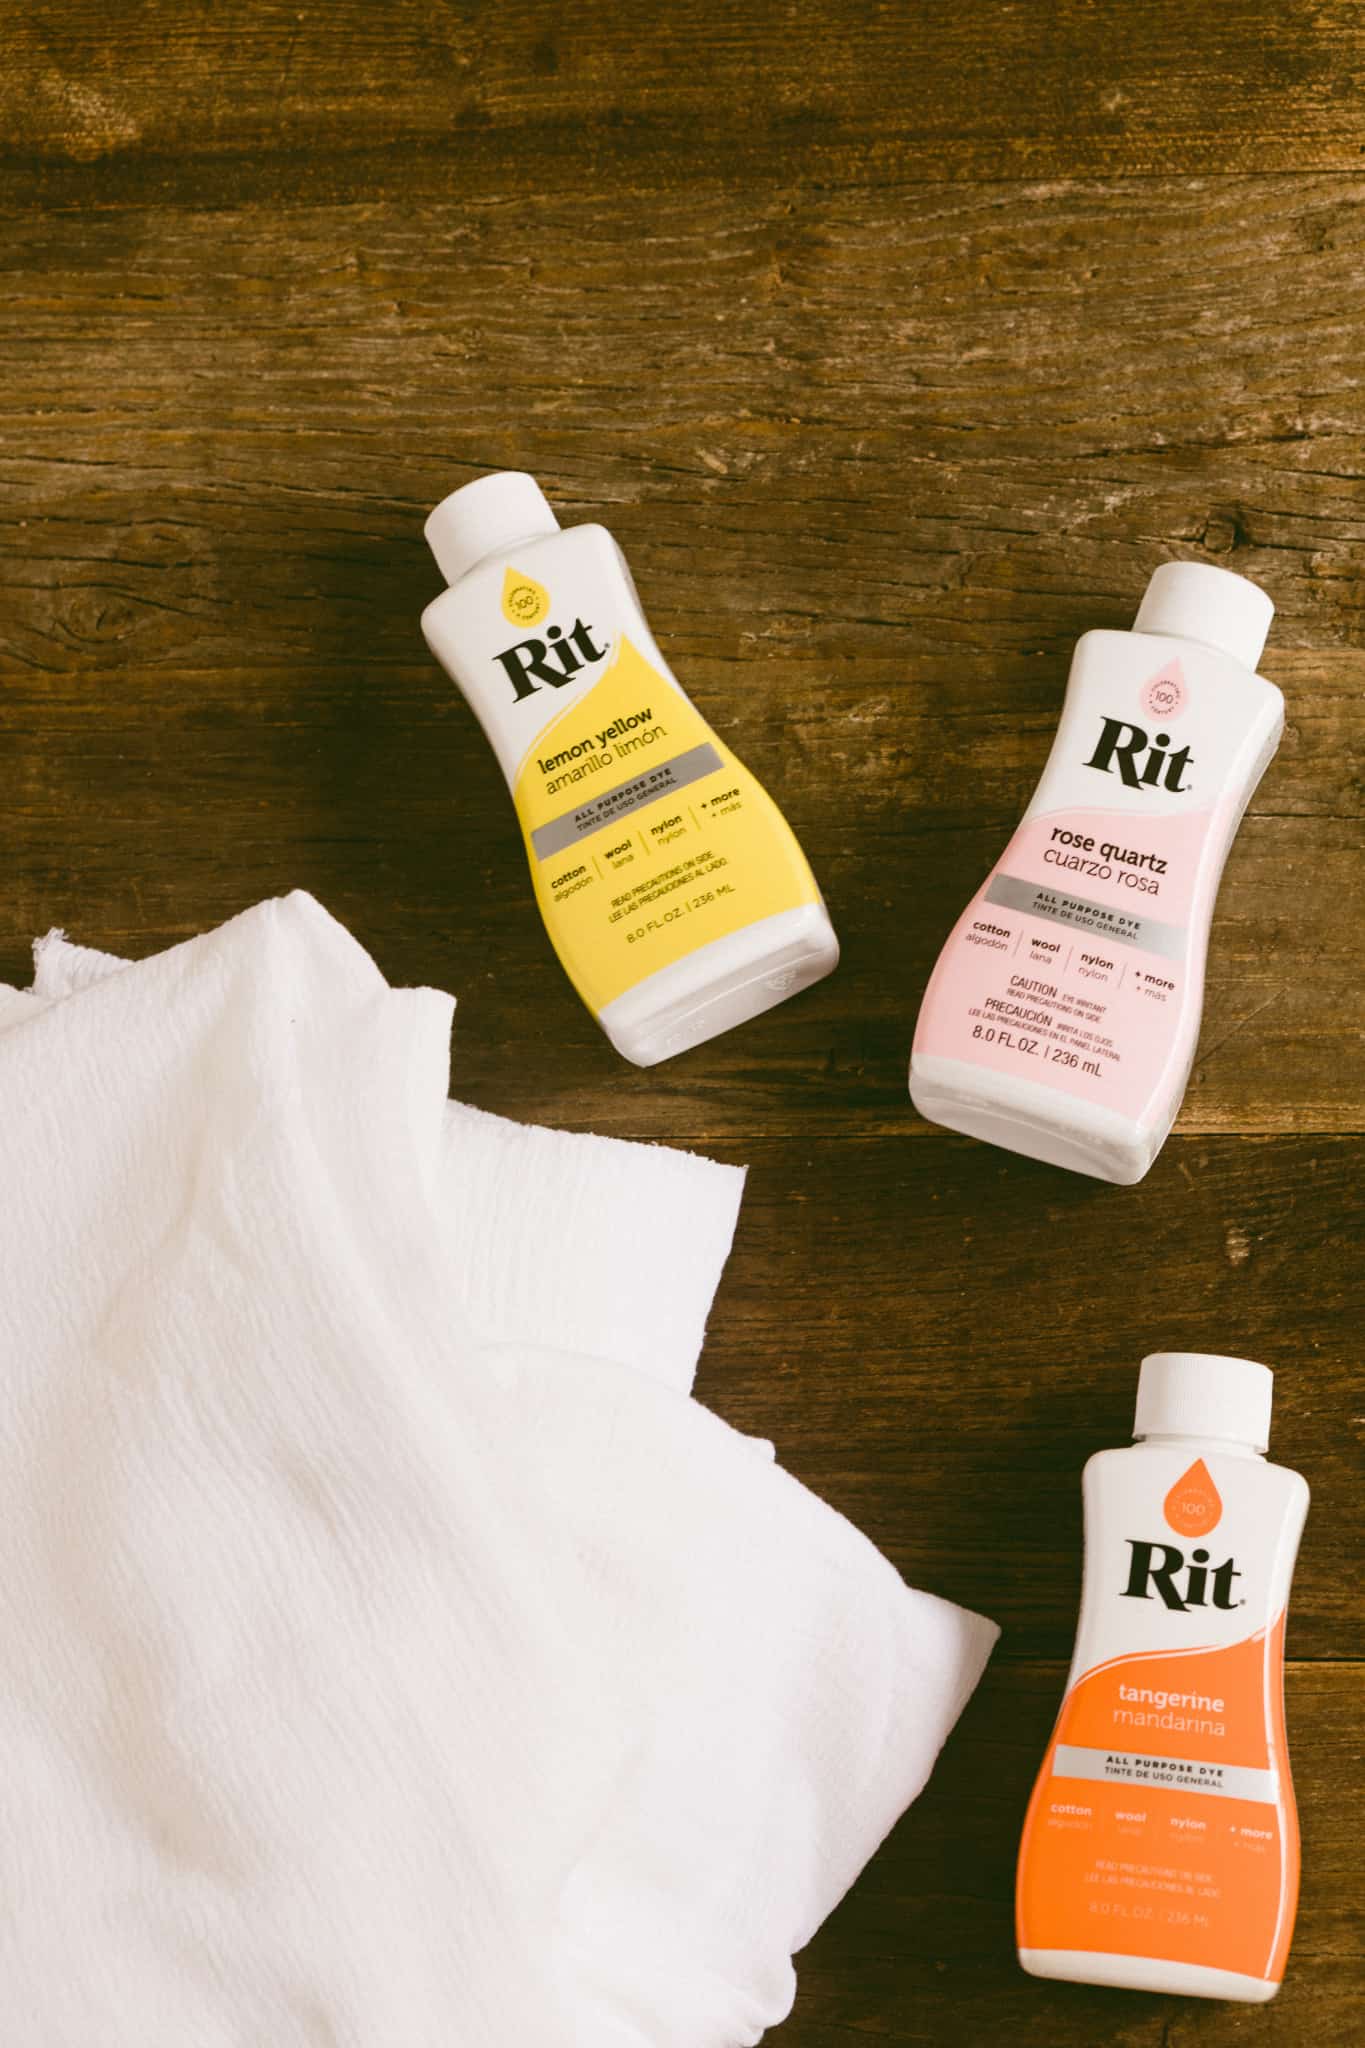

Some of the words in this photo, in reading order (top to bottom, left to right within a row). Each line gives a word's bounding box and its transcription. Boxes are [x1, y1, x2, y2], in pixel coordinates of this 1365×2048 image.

[515, 596, 533, 609] 100
[491, 617, 608, 703] Rit
[1156, 691, 1174, 704] 100
[537, 739, 595, 774] lemon
[595, 708, 652, 749] yellow
[546, 753, 613, 795] amarillo
[613, 725, 667, 758] limón
[1082, 716, 1194, 793] Rit
[575, 808, 594, 822] ALL
[597, 780, 647, 809] PURPOSE
[649, 768, 672, 783] DYE
[577, 814, 600, 831] TINTE
[602, 807, 616, 818] DE
[617, 798, 634, 810] USO
[636, 777, 677, 800] GENERAL
[711, 788, 740, 806] more
[651, 815, 682, 835] nylon
[657, 827, 687, 846] nylon
[604, 840, 632, 859] wool
[1051, 827, 1095, 851] rose
[1100, 843, 1168, 874] quartz
[551, 866, 586, 889] cotton
[611, 892, 632, 908] READ
[632, 866, 683, 896] PRECAUTIONS
[682, 860, 695, 870] ON
[1044, 849, 1111, 880] cuarzo
[1117, 870, 1160, 896] rosa
[608, 910, 624, 924] LEE
[623, 902, 639, 915] LAS
[695, 869, 705, 878] AL
[705, 857, 728, 872] LADO
[626, 928, 646, 943] 8.0
[692, 892, 714, 908] 236
[716, 884, 736, 896] ML
[1032, 901, 1058, 915] TINTE
[1060, 910, 1072, 919] DE
[1075, 914, 1094, 926] USO
[1096, 921, 1137, 939] GENERAL
[1036, 892, 1057, 904] ALL
[1062, 900, 1115, 921] PURPOSE
[1119, 918, 1141, 929] DYE
[973, 922, 1010, 938] cotton
[965, 933, 1008, 951] algodón
[1031, 938, 1060, 952] wool
[1029, 951, 1053, 964] lana
[1081, 953, 1114, 970] nylon
[1078, 967, 1108, 981] nylon
[1145, 974, 1175, 990] more
[1010, 975, 1058, 998] CAUTION
[985, 997, 1052, 1026] PRECAUCIÓN
[1007, 988, 1025, 999] READ
[1026, 994, 1072, 1013] PRECAUTIONS
[968, 1008, 981, 1017] LEE
[982, 1012, 996, 1021] LAS
[1049, 1031, 1059, 1040] EN
[1069, 1038, 1090, 1051] PANEL
[1092, 1046, 1120, 1061] LATERAL
[972, 1025, 996, 1041] 8.0
[998, 1032, 1015, 1048] FL
[1052, 1048, 1079, 1068] 236
[1082, 1061, 1102, 1077] mL
[1119, 1539, 1242, 1613] Rit
[1119, 1683, 1225, 1713] tangerine
[1113, 1709, 1225, 1736] mandarina
[1105, 1767, 1132, 1776] TINTE
[1136, 1770, 1149, 1778] DE
[1153, 1772, 1173, 1781] USO
[1176, 1775, 1223, 1788] GENERAL
[1107, 1756, 1128, 1765] ALL
[1135, 1759, 1193, 1772] PURPOSE
[1200, 1768, 1223, 1777] DYE
[1050, 1803, 1092, 1816] cotton
[1115, 1811, 1146, 1822] wool
[1170, 1818, 1206, 1830] nylon
[1240, 1828, 1272, 1840] more
